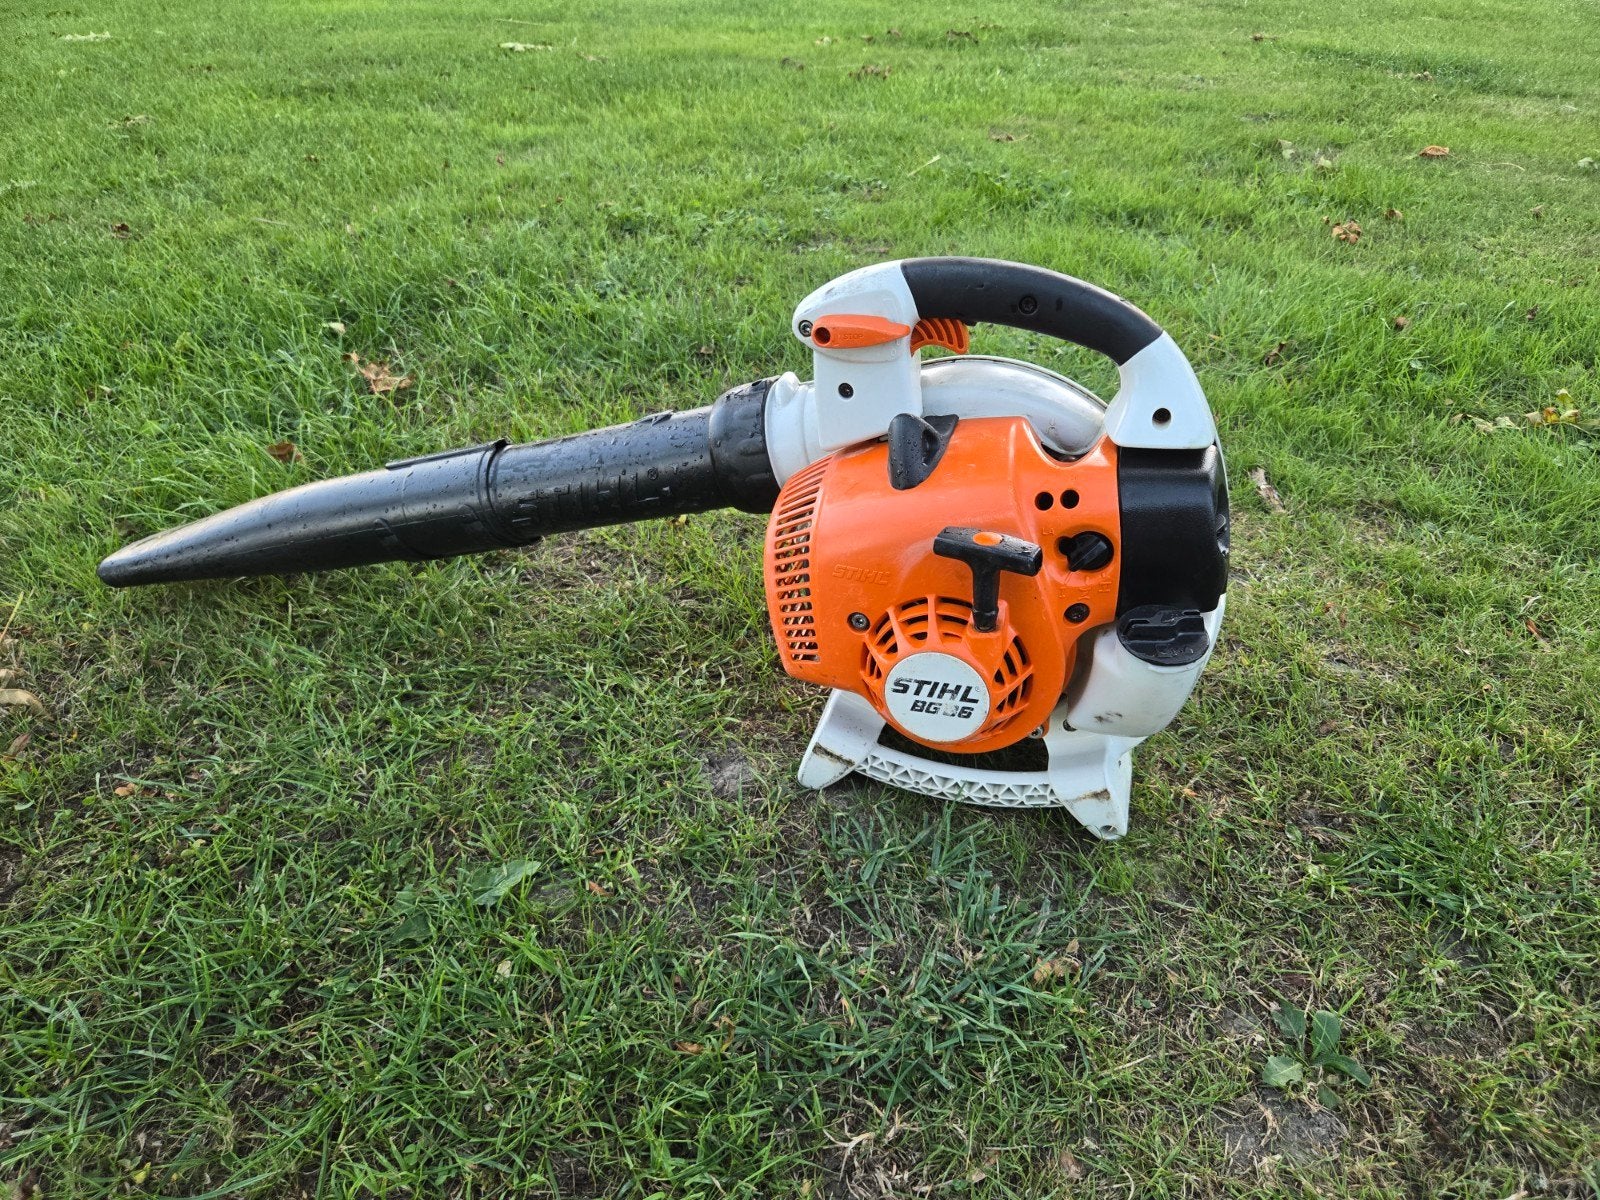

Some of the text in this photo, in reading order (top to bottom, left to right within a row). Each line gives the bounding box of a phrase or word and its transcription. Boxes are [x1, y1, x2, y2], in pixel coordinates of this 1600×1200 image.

[832, 563, 890, 586] STIHL
[891, 677, 979, 704] STIHL
[910, 699, 942, 715] BG
